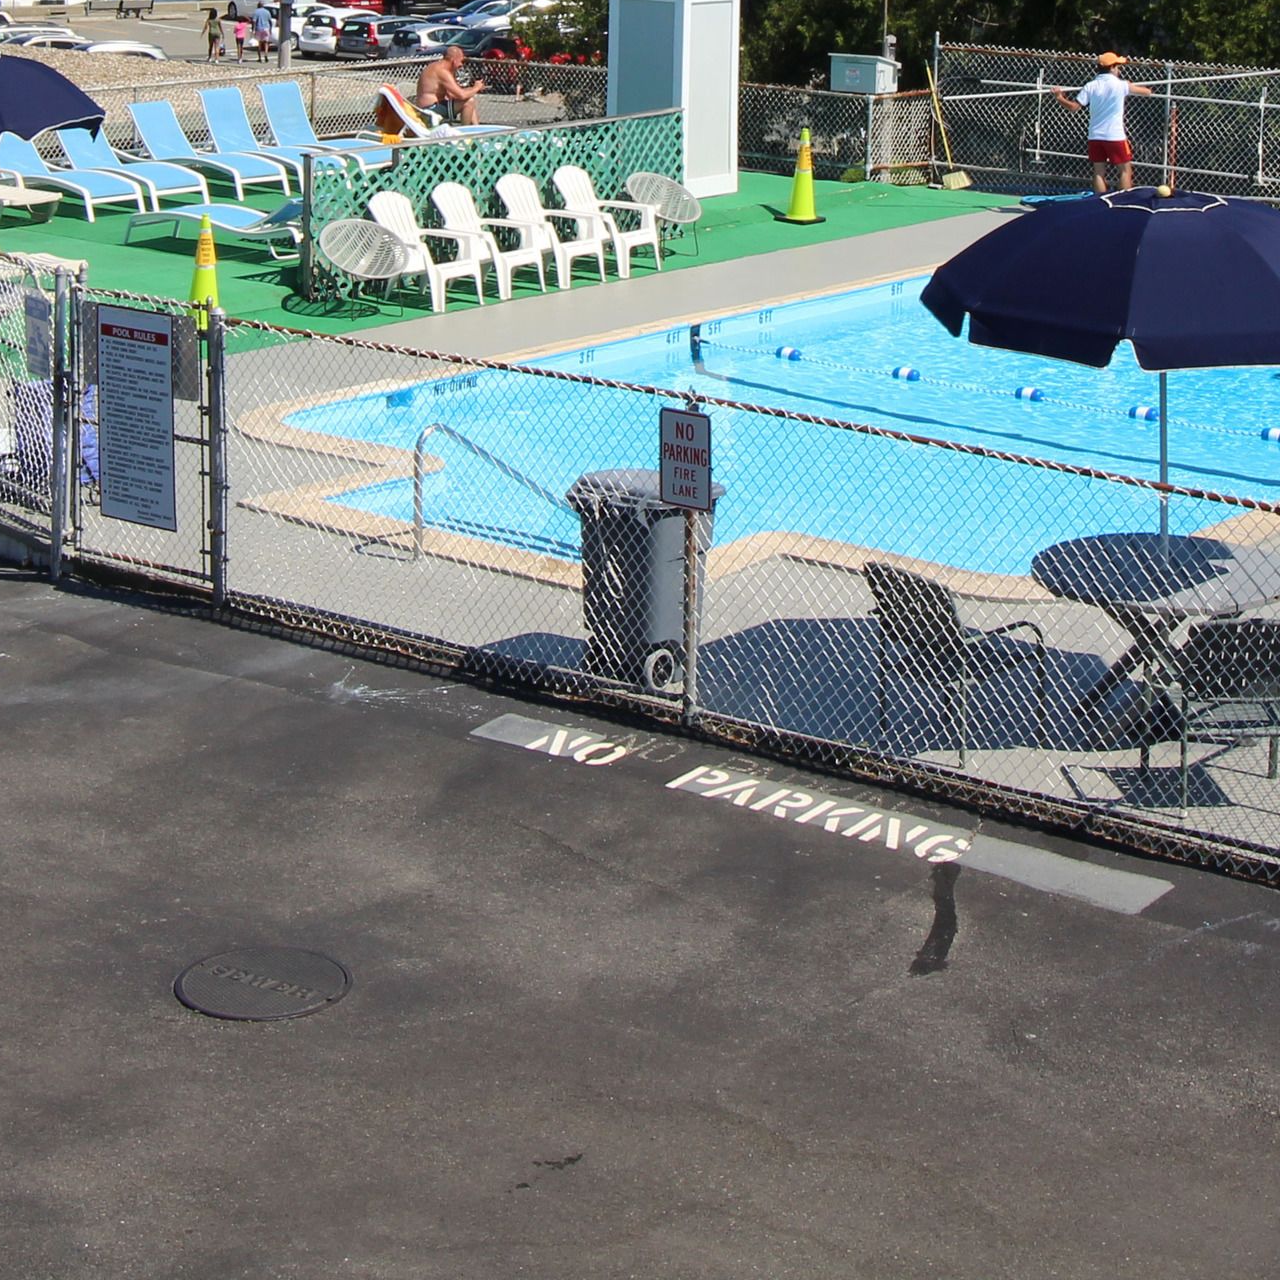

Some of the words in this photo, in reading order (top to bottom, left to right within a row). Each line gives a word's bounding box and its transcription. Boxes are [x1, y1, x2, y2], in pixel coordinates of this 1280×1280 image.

[112, 327, 131, 338] POOL
[133, 330, 157, 342] RULES
[713, 320, 722, 334] FT
[672, 331, 680, 344] FT
[579, 352, 585, 364] 3
[586, 350, 595, 363] FT
[675, 421, 695, 441] NO
[663, 442, 707, 467] PARKING
[673, 466, 697, 482] FIRE
[672, 483, 698, 499] LANE
[525, 730, 627, 766] NO
[664, 765, 973, 863] PARKING
